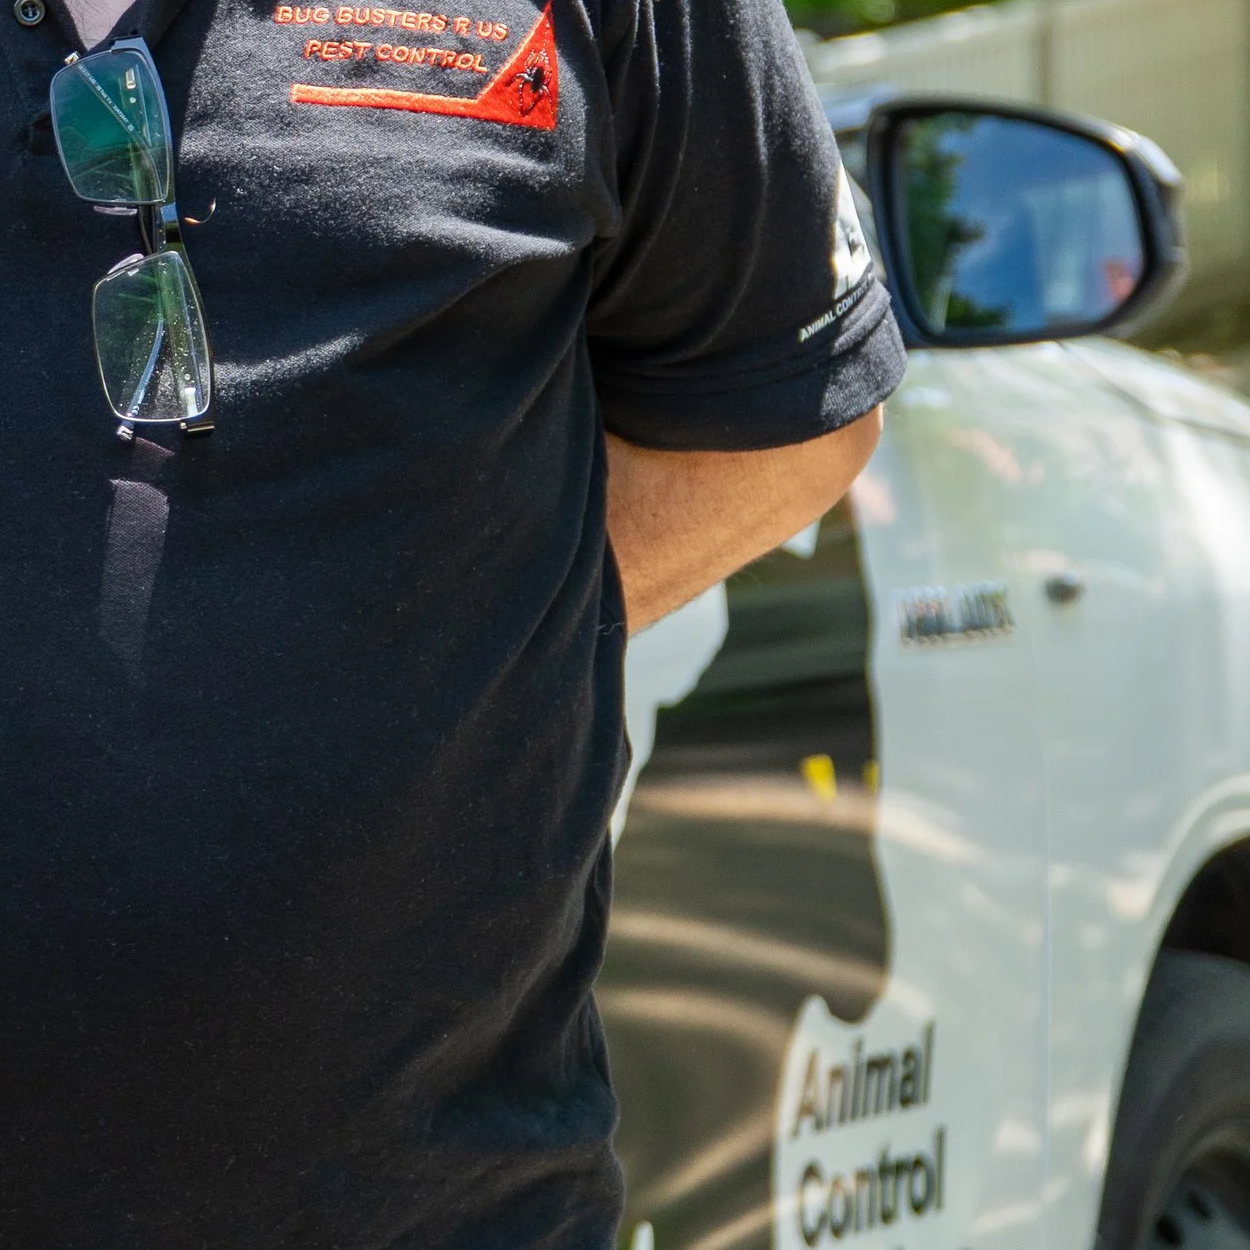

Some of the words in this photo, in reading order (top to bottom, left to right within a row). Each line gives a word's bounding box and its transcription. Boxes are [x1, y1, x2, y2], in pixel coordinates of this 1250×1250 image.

[276, 6, 329, 24] BUG
[335, 7, 447, 33] BUSTERS
[454, 16, 471, 35] R
[477, 20, 508, 41] US
[304, 39, 371, 61] PEST
[376, 42, 488, 73] CONTROL
[798, 310, 836, 343] ANIMAL
[789, 1020, 934, 1140] Animal
[800, 1122, 946, 1248] Control
